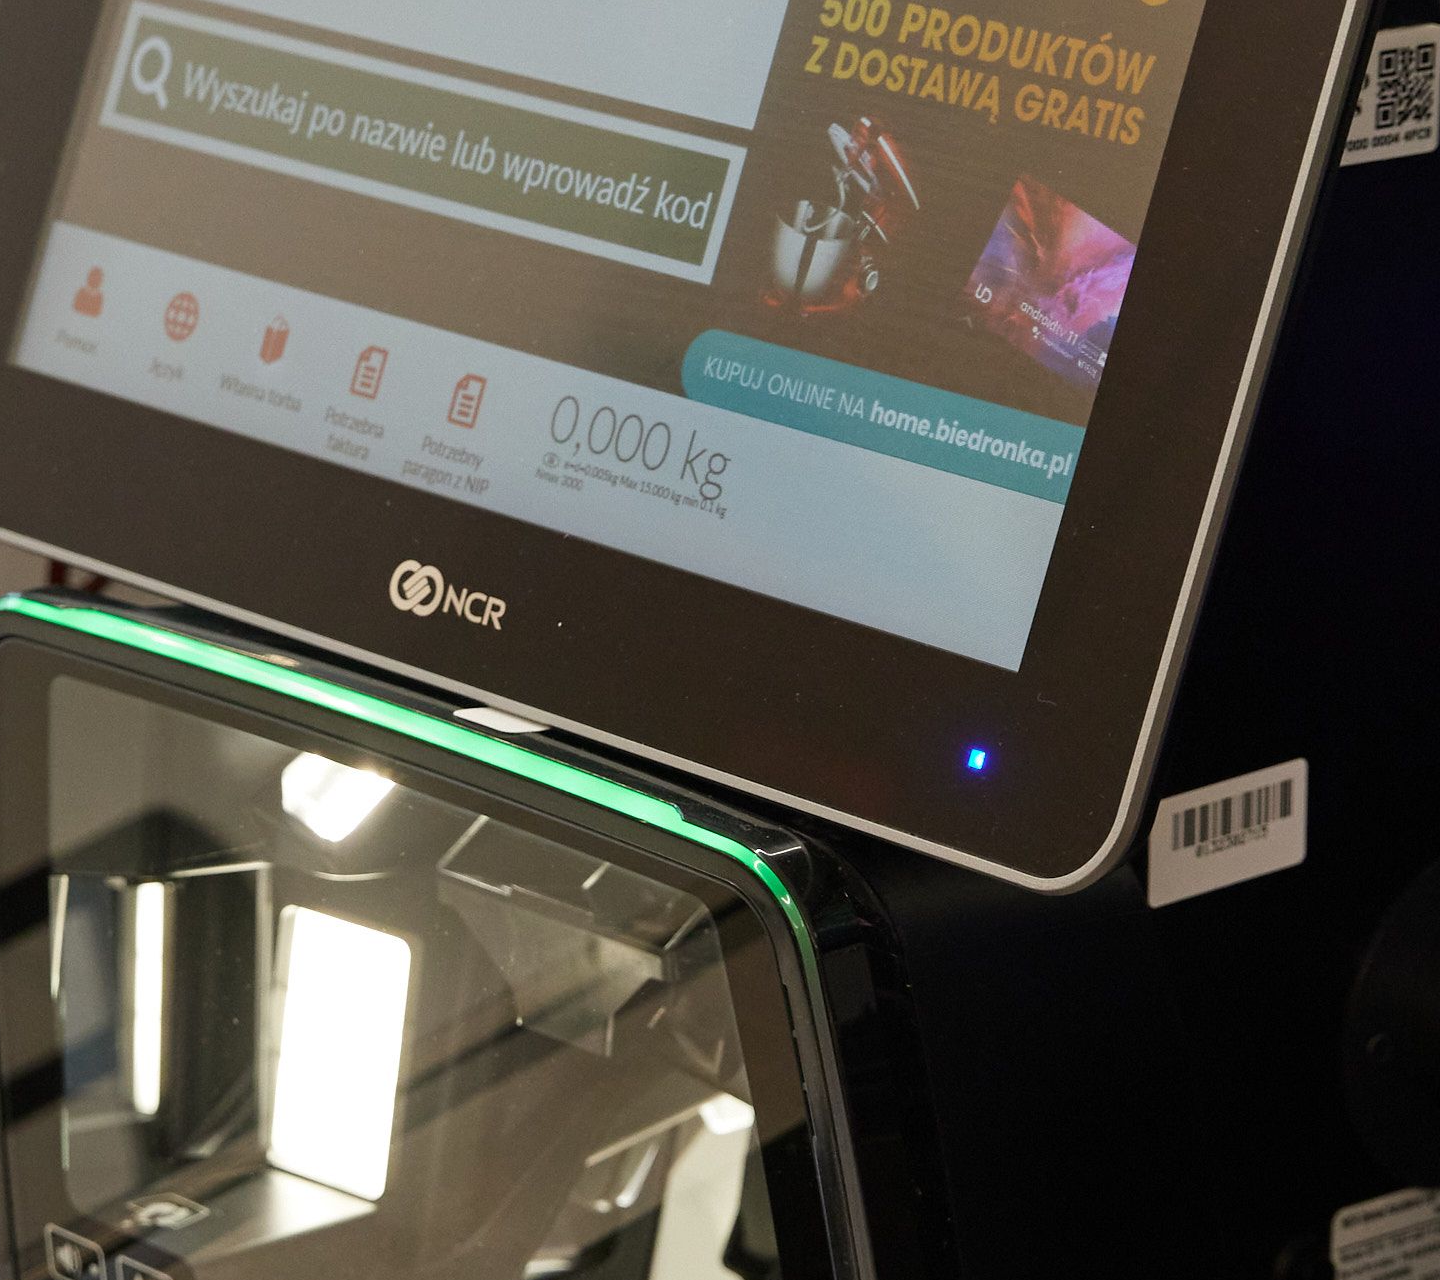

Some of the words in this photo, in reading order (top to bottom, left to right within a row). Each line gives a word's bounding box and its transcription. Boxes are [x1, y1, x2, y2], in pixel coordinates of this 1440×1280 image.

[803, 35, 832, 74] Z
[832, 41, 1001, 125] DOSTAWĄ
[1014, 84, 1148, 146] GRATIS
[896, 1, 1157, 96] PRODUKTÓW
[182, 61, 308, 134] Wyszukaj
[305, 101, 346, 141] po
[350, 110, 447, 162] nazwie
[451, 135, 497, 176] lub
[502, 153, 651, 216] wprowadź
[653, 179, 714, 231] kod
[421, 435, 486, 471] Potrzebny
[550, 394, 672, 471] 0,000
[679, 429, 732, 501] kg
[702, 356, 766, 391] KUPUJ
[767, 373, 837, 412] ONLINE
[836, 391, 865, 420] NA
[869, 400, 1074, 480] home.biedronka.pl
[401, 458, 452, 489] paragon
[463, 468, 491, 498] NIP
[441, 583, 507, 631] NCR
